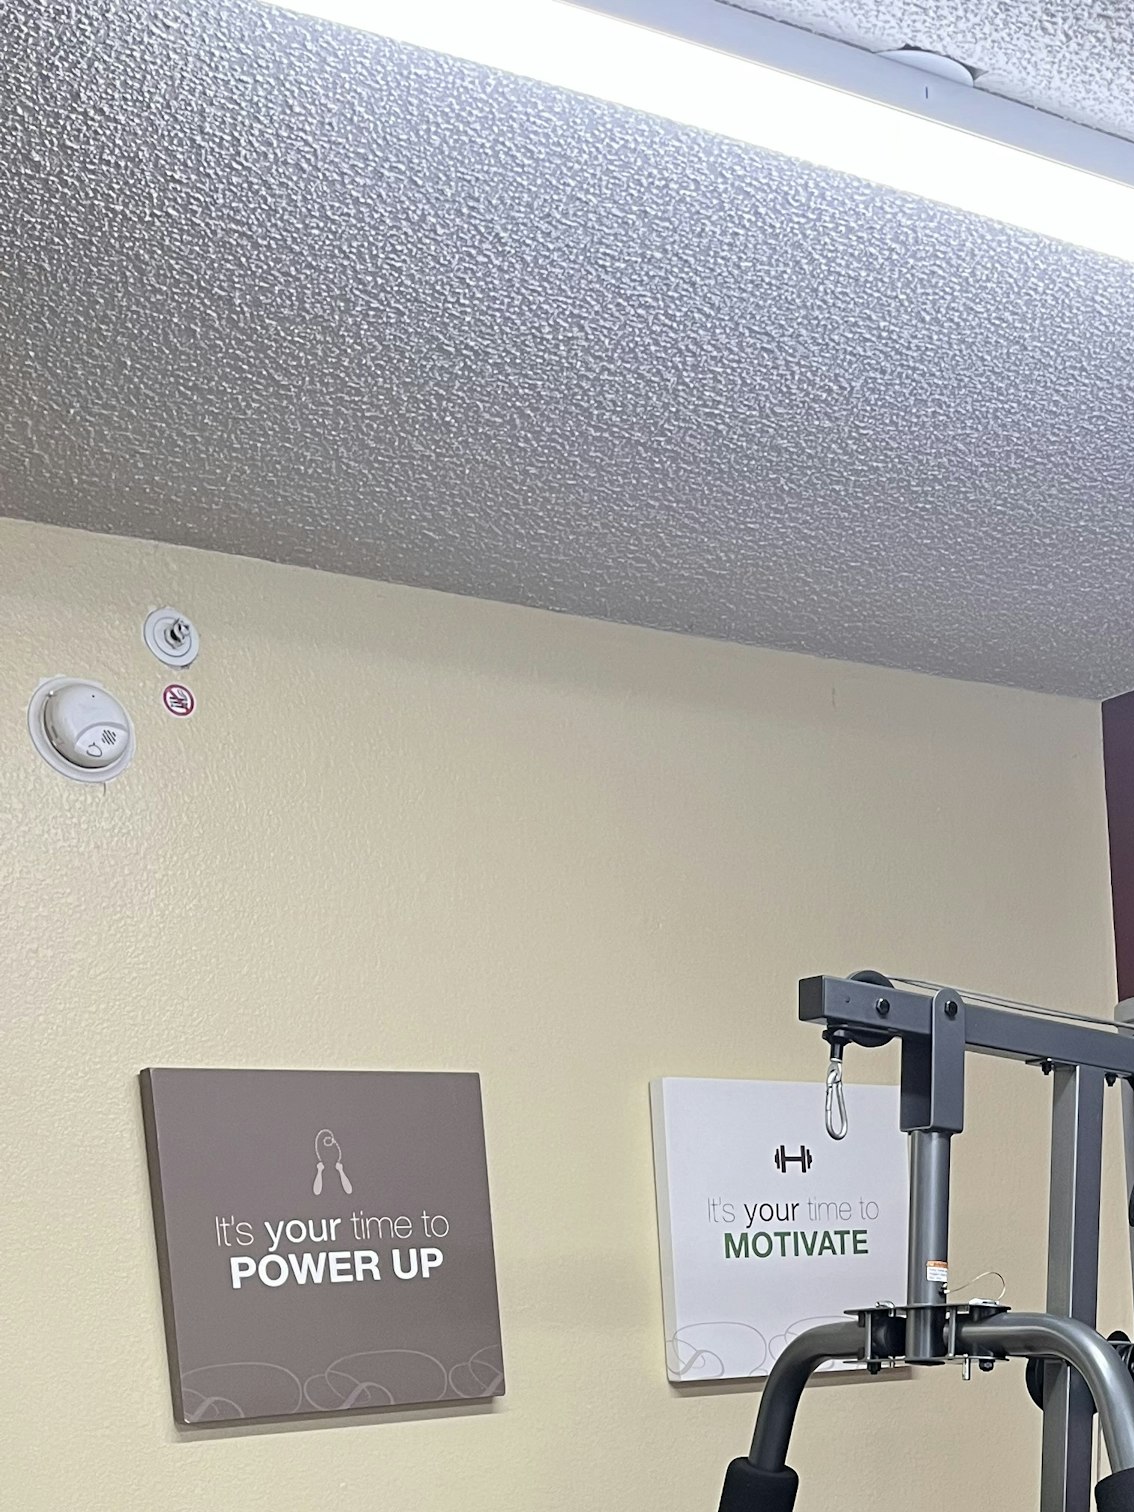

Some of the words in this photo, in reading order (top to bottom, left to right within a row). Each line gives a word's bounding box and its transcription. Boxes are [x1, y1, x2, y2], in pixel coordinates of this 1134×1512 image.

[215, 1216, 254, 1247] It's
[264, 1217, 341, 1251] your
[350, 1210, 413, 1240] time
[421, 1210, 450, 1238] to
[707, 1196, 736, 1223] It's
[743, 1201, 800, 1229] your
[807, 1196, 852, 1222] time
[859, 1196, 880, 1221] to
[724, 1229, 869, 1259] MOTIVATE
[229, 1250, 382, 1290] POWER
[392, 1247, 445, 1281] UP
